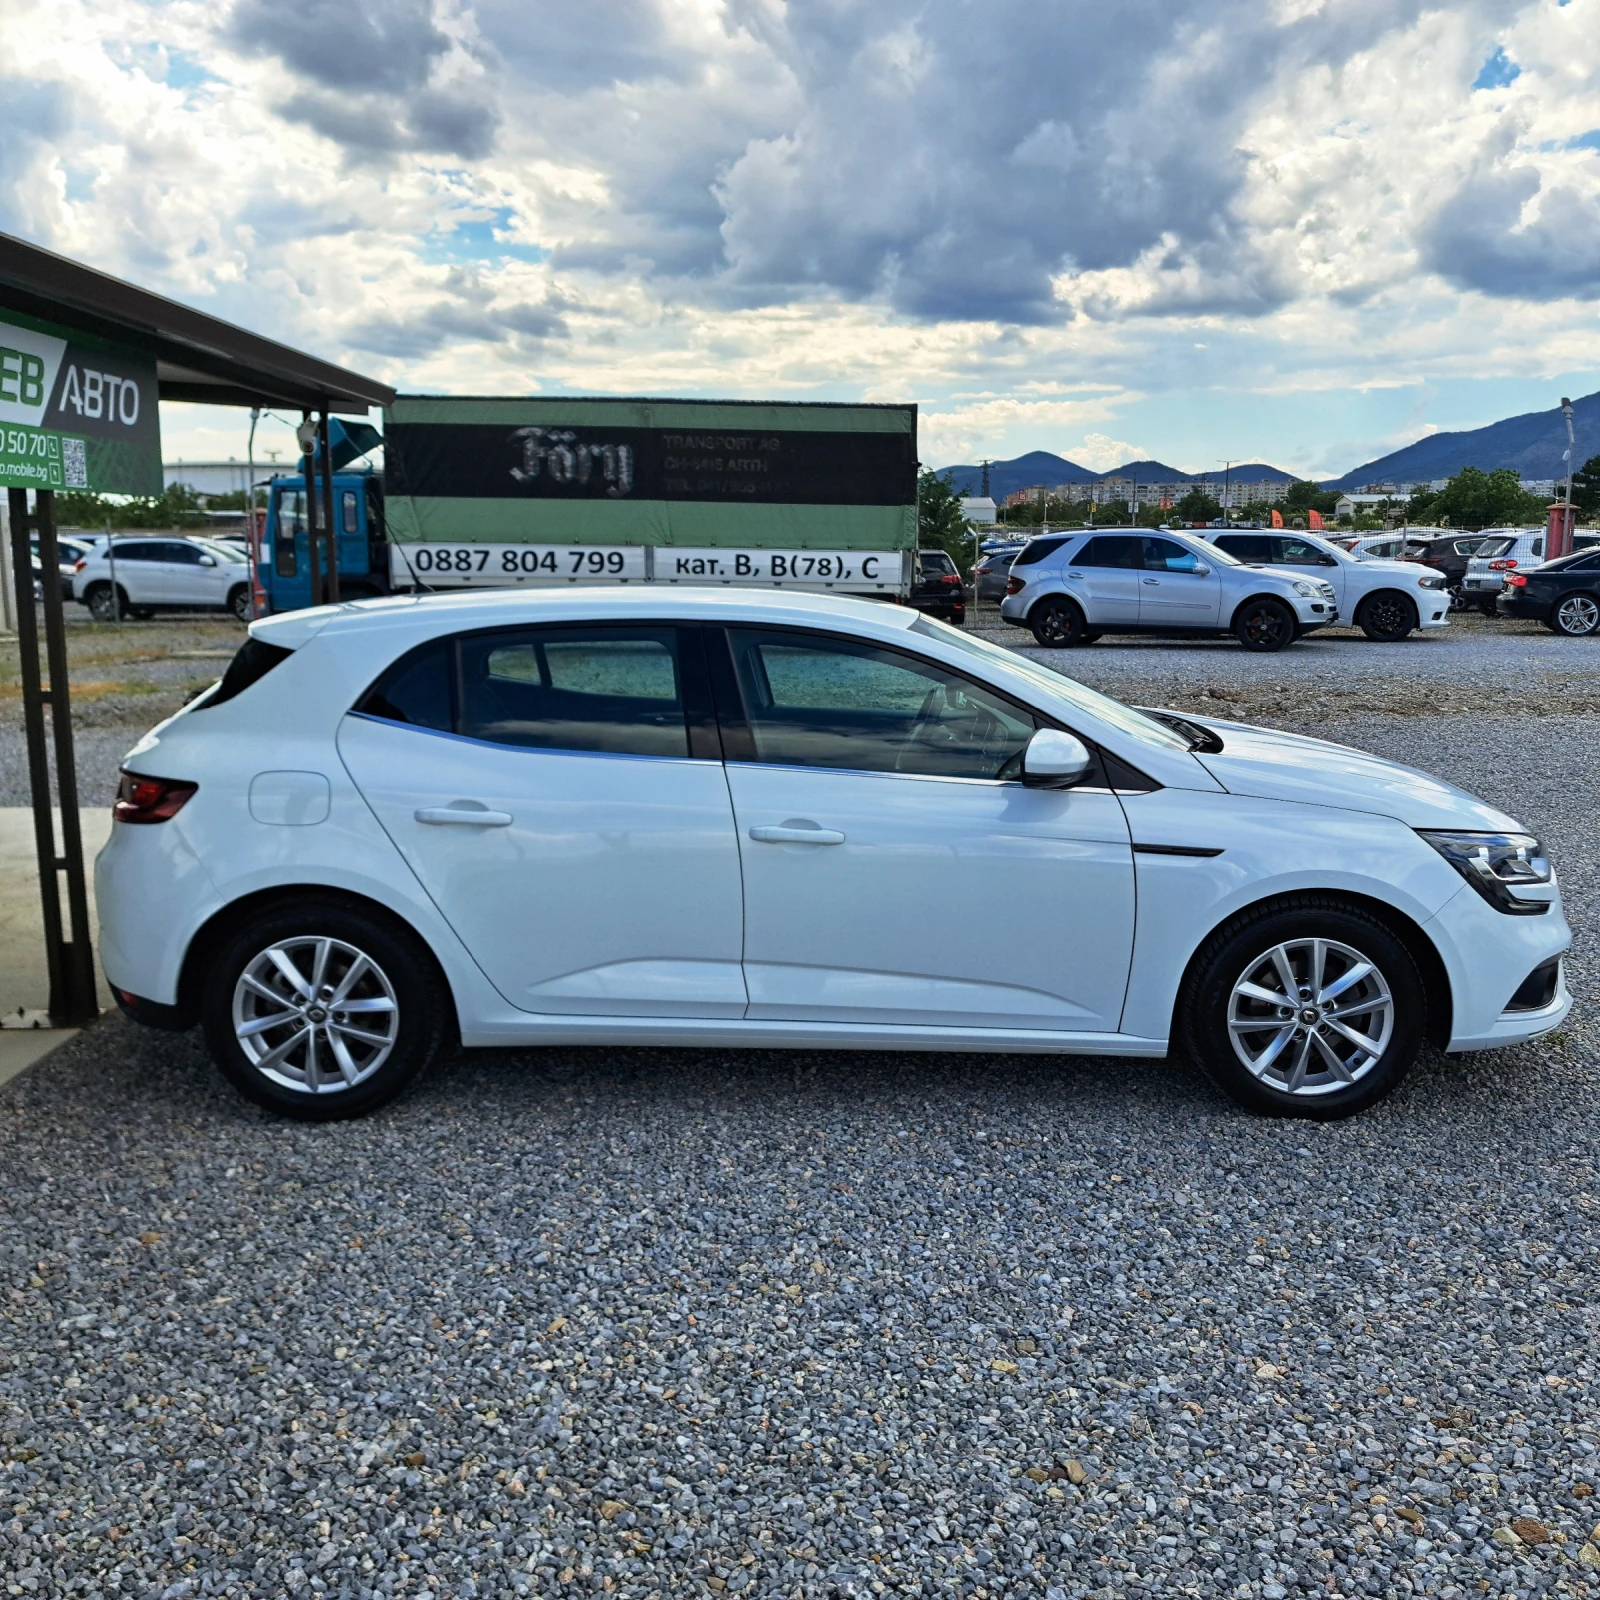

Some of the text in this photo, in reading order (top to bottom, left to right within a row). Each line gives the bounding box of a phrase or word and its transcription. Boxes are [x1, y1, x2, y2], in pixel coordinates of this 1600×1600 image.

[58, 364, 140, 426] АВТО
[7, 430, 27, 455] 50
[29, 433, 47, 457] 70
[663, 435, 780, 451] TRANSPORT AG
[415, 549, 624, 574] 0887 804 799
[676, 557, 725, 575] кат.
